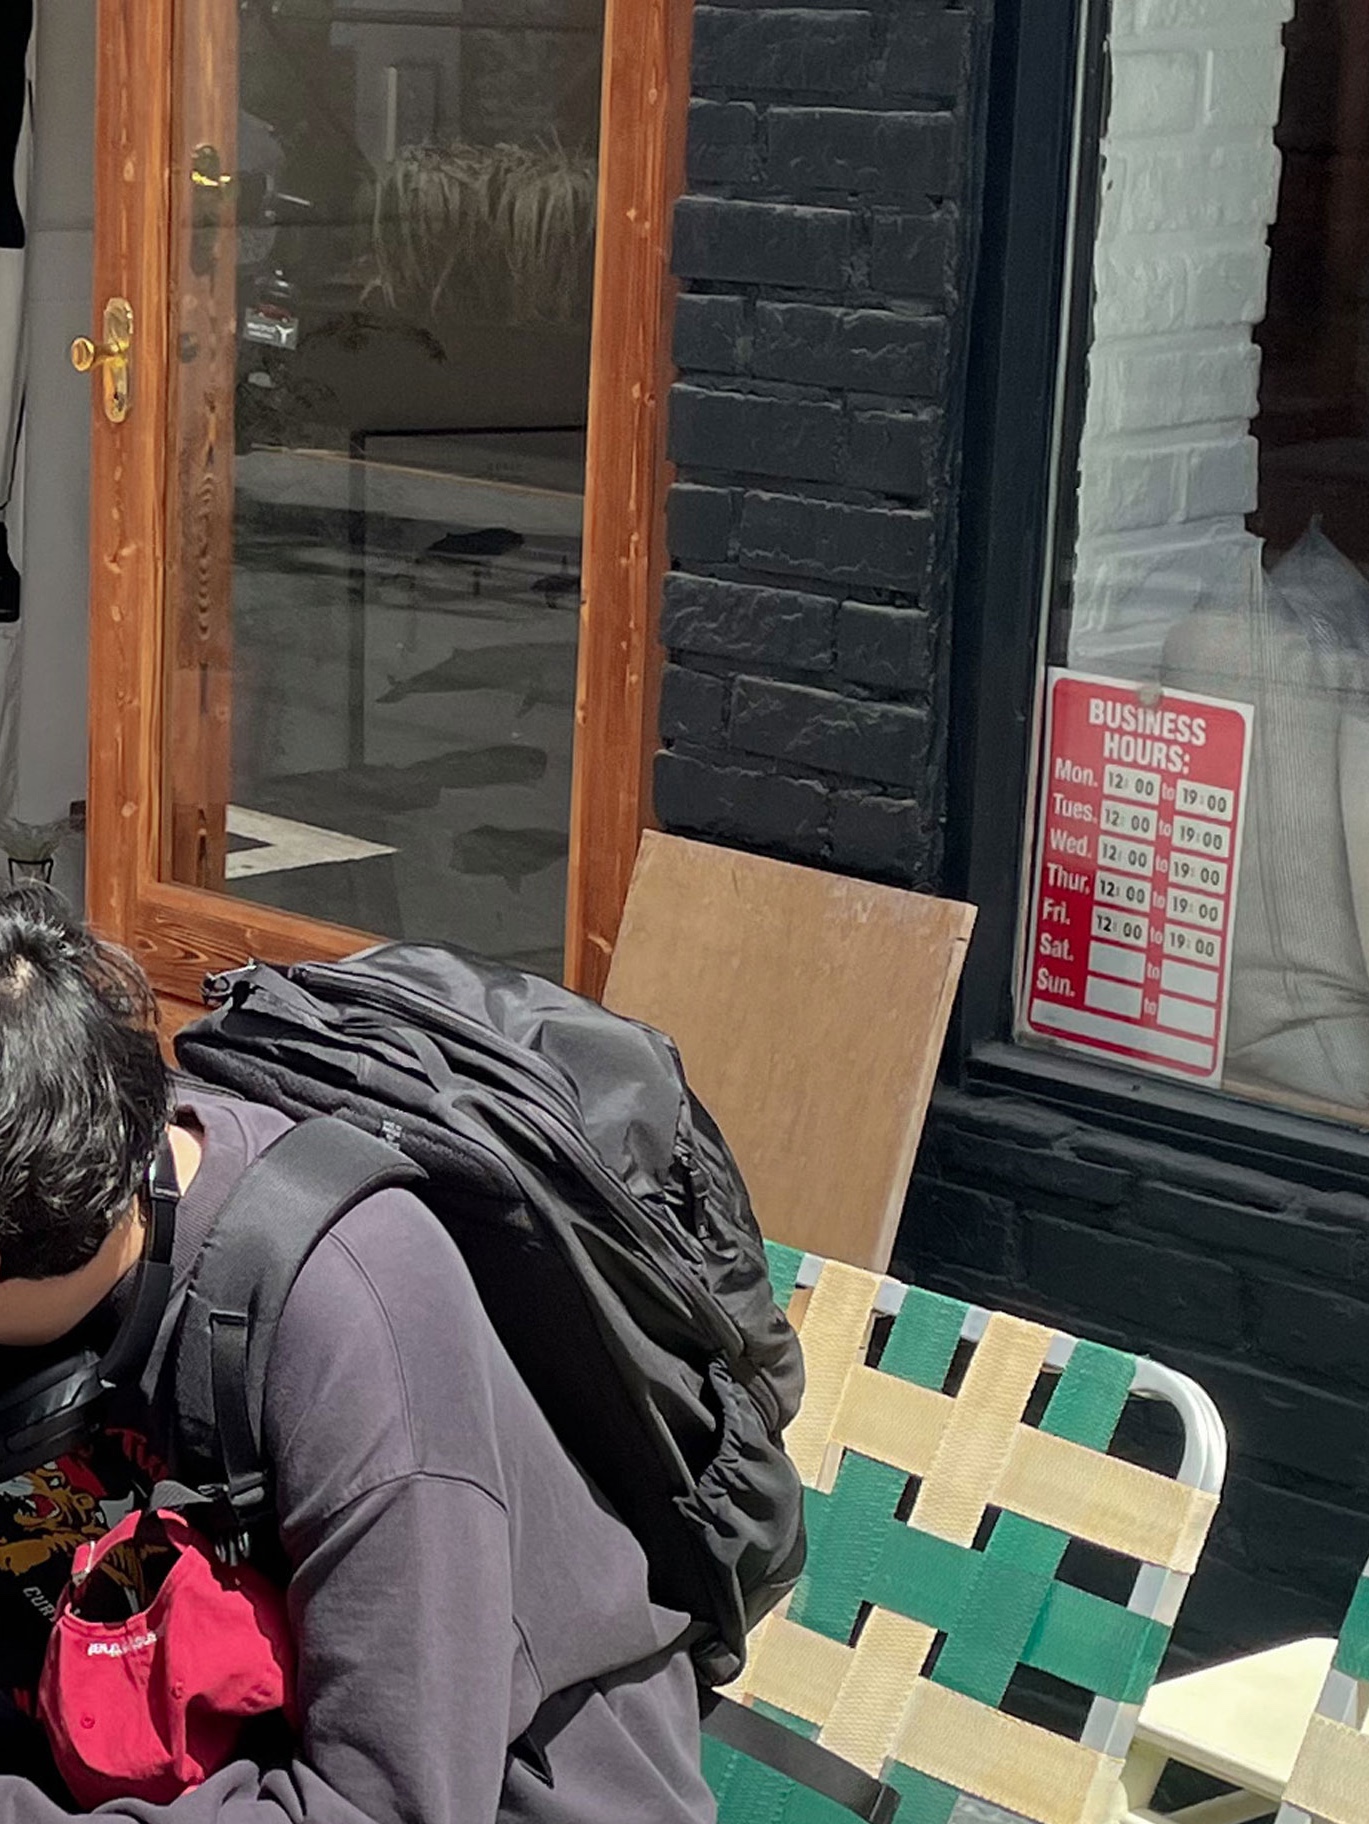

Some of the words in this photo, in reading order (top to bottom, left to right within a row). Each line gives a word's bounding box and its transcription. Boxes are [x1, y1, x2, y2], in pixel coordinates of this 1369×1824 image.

[1088, 698, 1207, 747] BUSINESS
[1103, 731, 1191, 775] HOURS:
[1054, 758, 1099, 787] Mon.
[1161, 783, 1175, 800] to
[1052, 793, 1098, 823] Tues.
[1158, 820, 1172, 837] to
[1049, 828, 1093, 859] Wed.
[1155, 855, 1169, 873] to
[1046, 862, 1090, 895] Thur.
[1152, 891, 1166, 908] to
[1042, 897, 1071, 925] Fri.
[1149, 926, 1163, 944] to
[1039, 932, 1074, 961] Sat.
[1146, 962, 1160, 981] to
[1036, 967, 1076, 997] Sun.
[1143, 997, 1157, 1016] to
[23, 1586, 56, 1622] CUR
